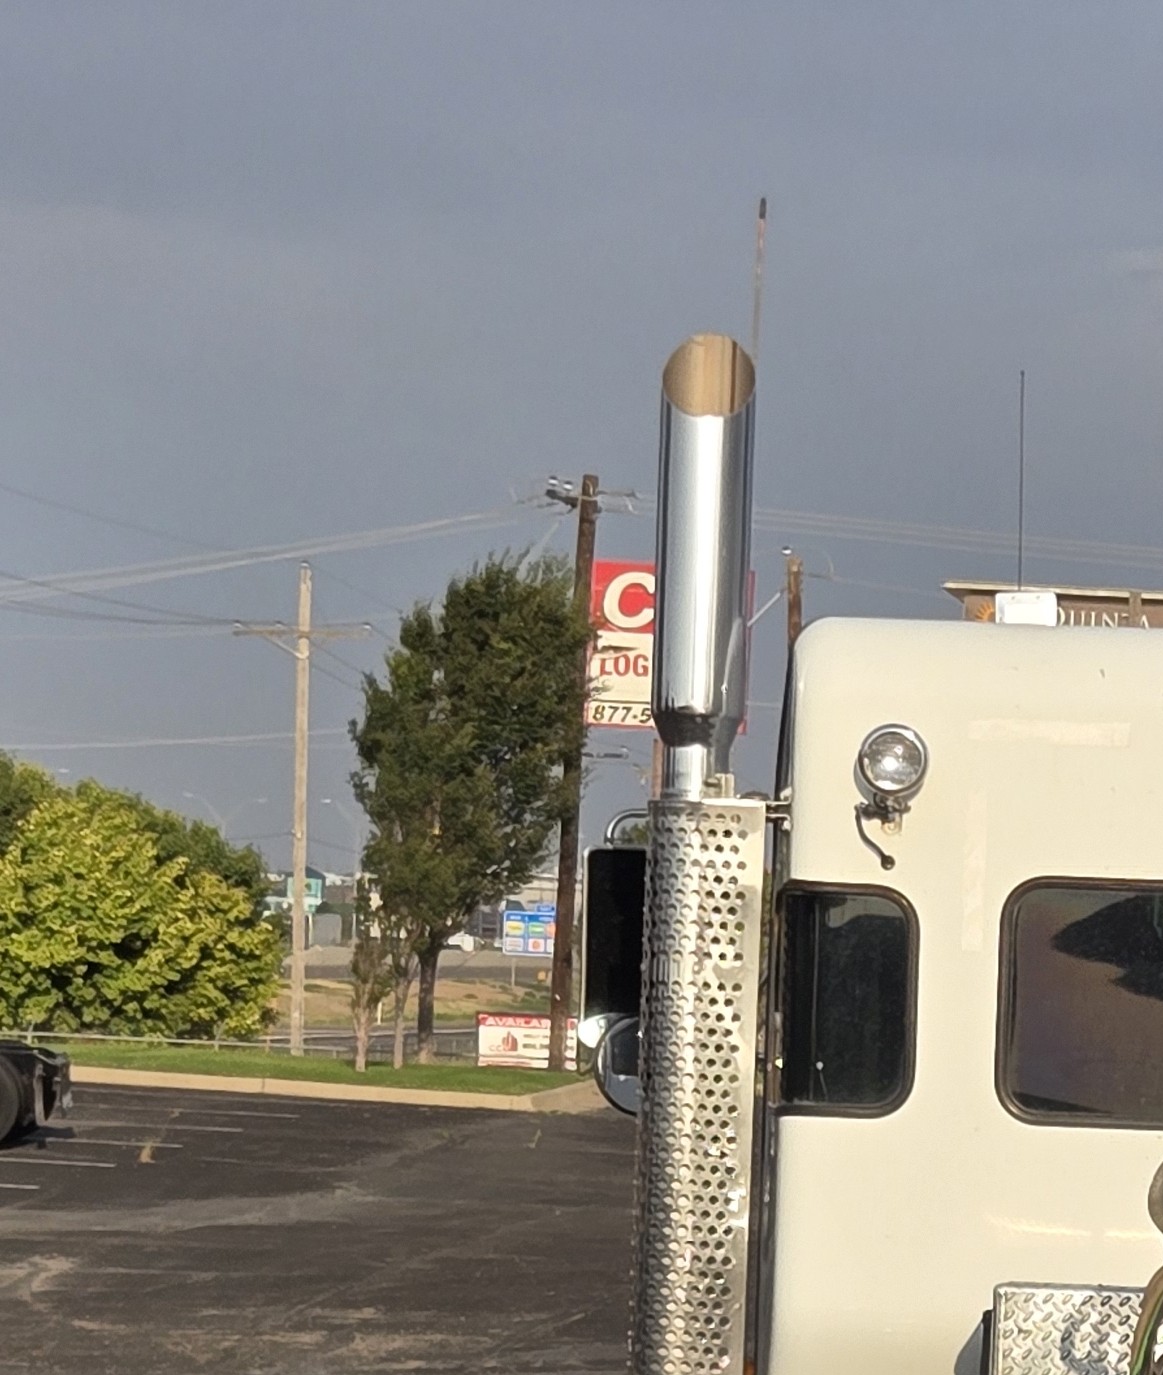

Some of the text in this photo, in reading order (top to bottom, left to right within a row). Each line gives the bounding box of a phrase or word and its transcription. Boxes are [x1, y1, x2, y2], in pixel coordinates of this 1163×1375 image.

[603, 571, 655, 628] C
[600, 653, 649, 677] LOG
[592, 705, 652, 724] 877-5
